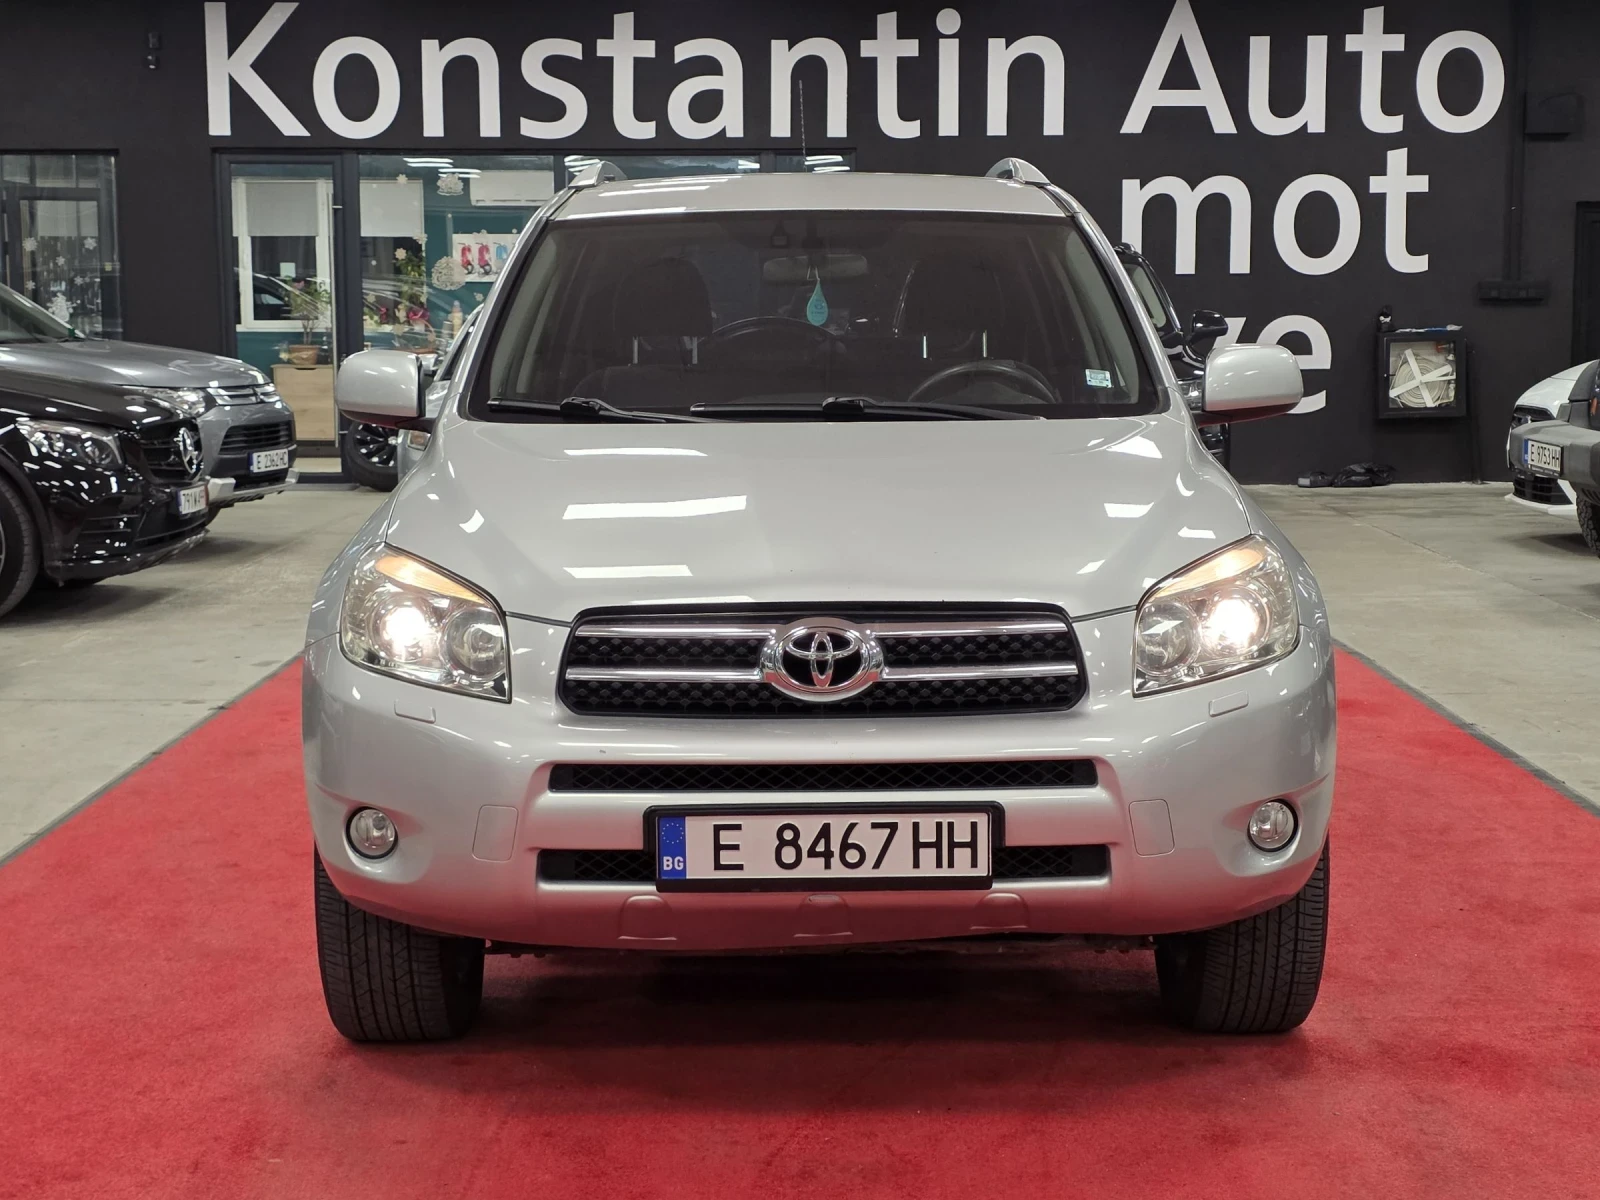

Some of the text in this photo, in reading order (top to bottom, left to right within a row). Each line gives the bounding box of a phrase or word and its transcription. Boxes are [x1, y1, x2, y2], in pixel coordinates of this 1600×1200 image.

[204, 0, 1505, 140] Konstantin Auto
[1121, 148, 1429, 281] mot
[663, 856, 684, 871] BG
[713, 821, 978, 871] E 8467 HH
